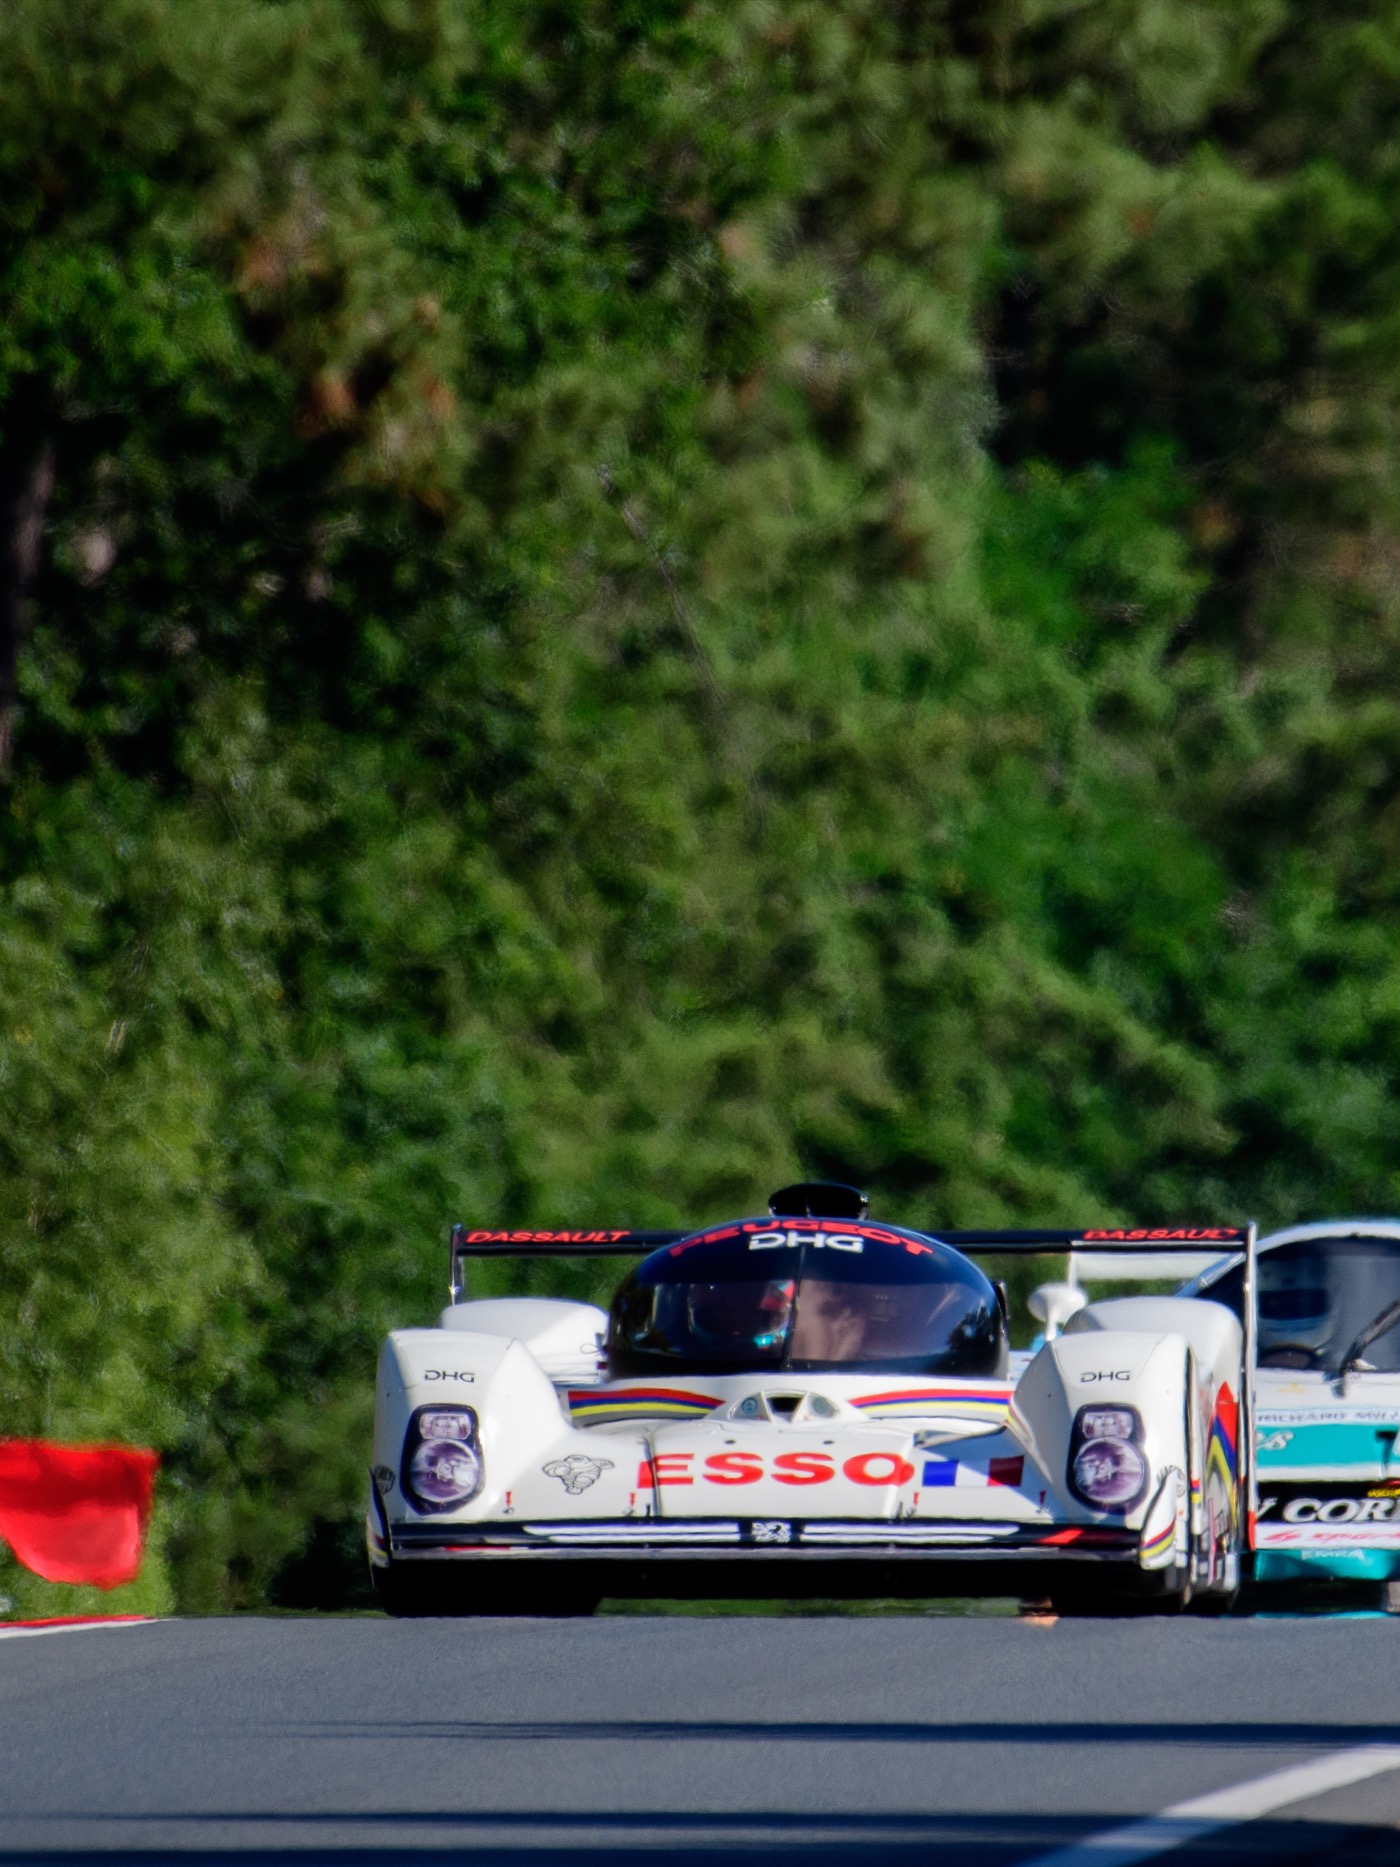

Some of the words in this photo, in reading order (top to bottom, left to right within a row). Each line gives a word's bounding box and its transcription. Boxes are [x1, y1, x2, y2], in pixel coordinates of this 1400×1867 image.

[465, 1229, 631, 1244] DASSAULT
[669, 1219, 933, 1257] PEUGEOT
[749, 1231, 864, 1253] DHG
[1083, 1229, 1239, 1241] DASSAULT
[424, 1370, 476, 1384] DHG
[1080, 1370, 1131, 1384] DHG
[636, 1451, 916, 1489] ESSO
